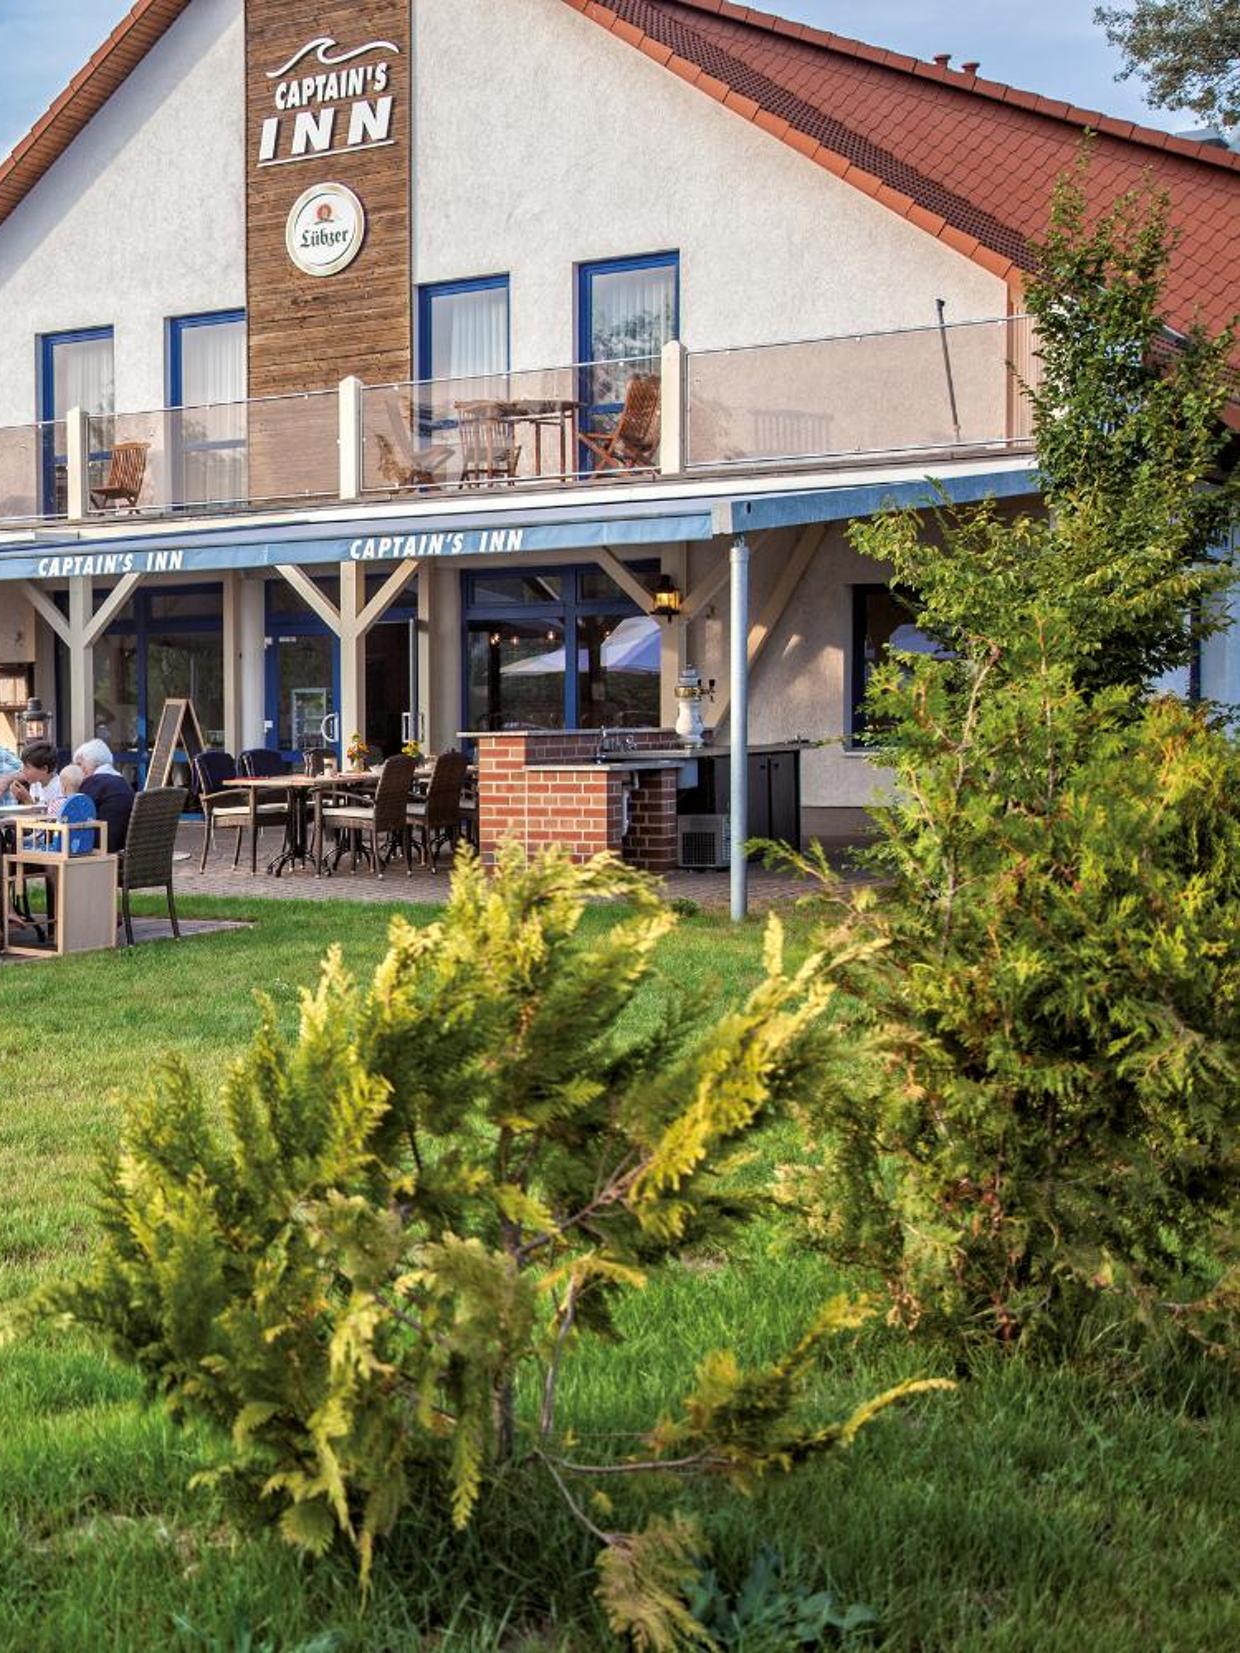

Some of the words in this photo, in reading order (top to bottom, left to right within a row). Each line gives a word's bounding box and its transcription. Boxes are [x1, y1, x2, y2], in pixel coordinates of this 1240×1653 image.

[275, 62, 388, 110] CAPTAIN'S
[259, 96, 393, 161] INN
[300, 228, 349, 248] Lübzer
[350, 533, 464, 559] CAPTAIN'S
[479, 529, 523, 552] INN
[38, 553, 134, 576] CAPTAIN'S
[147, 551, 184, 571] INN
